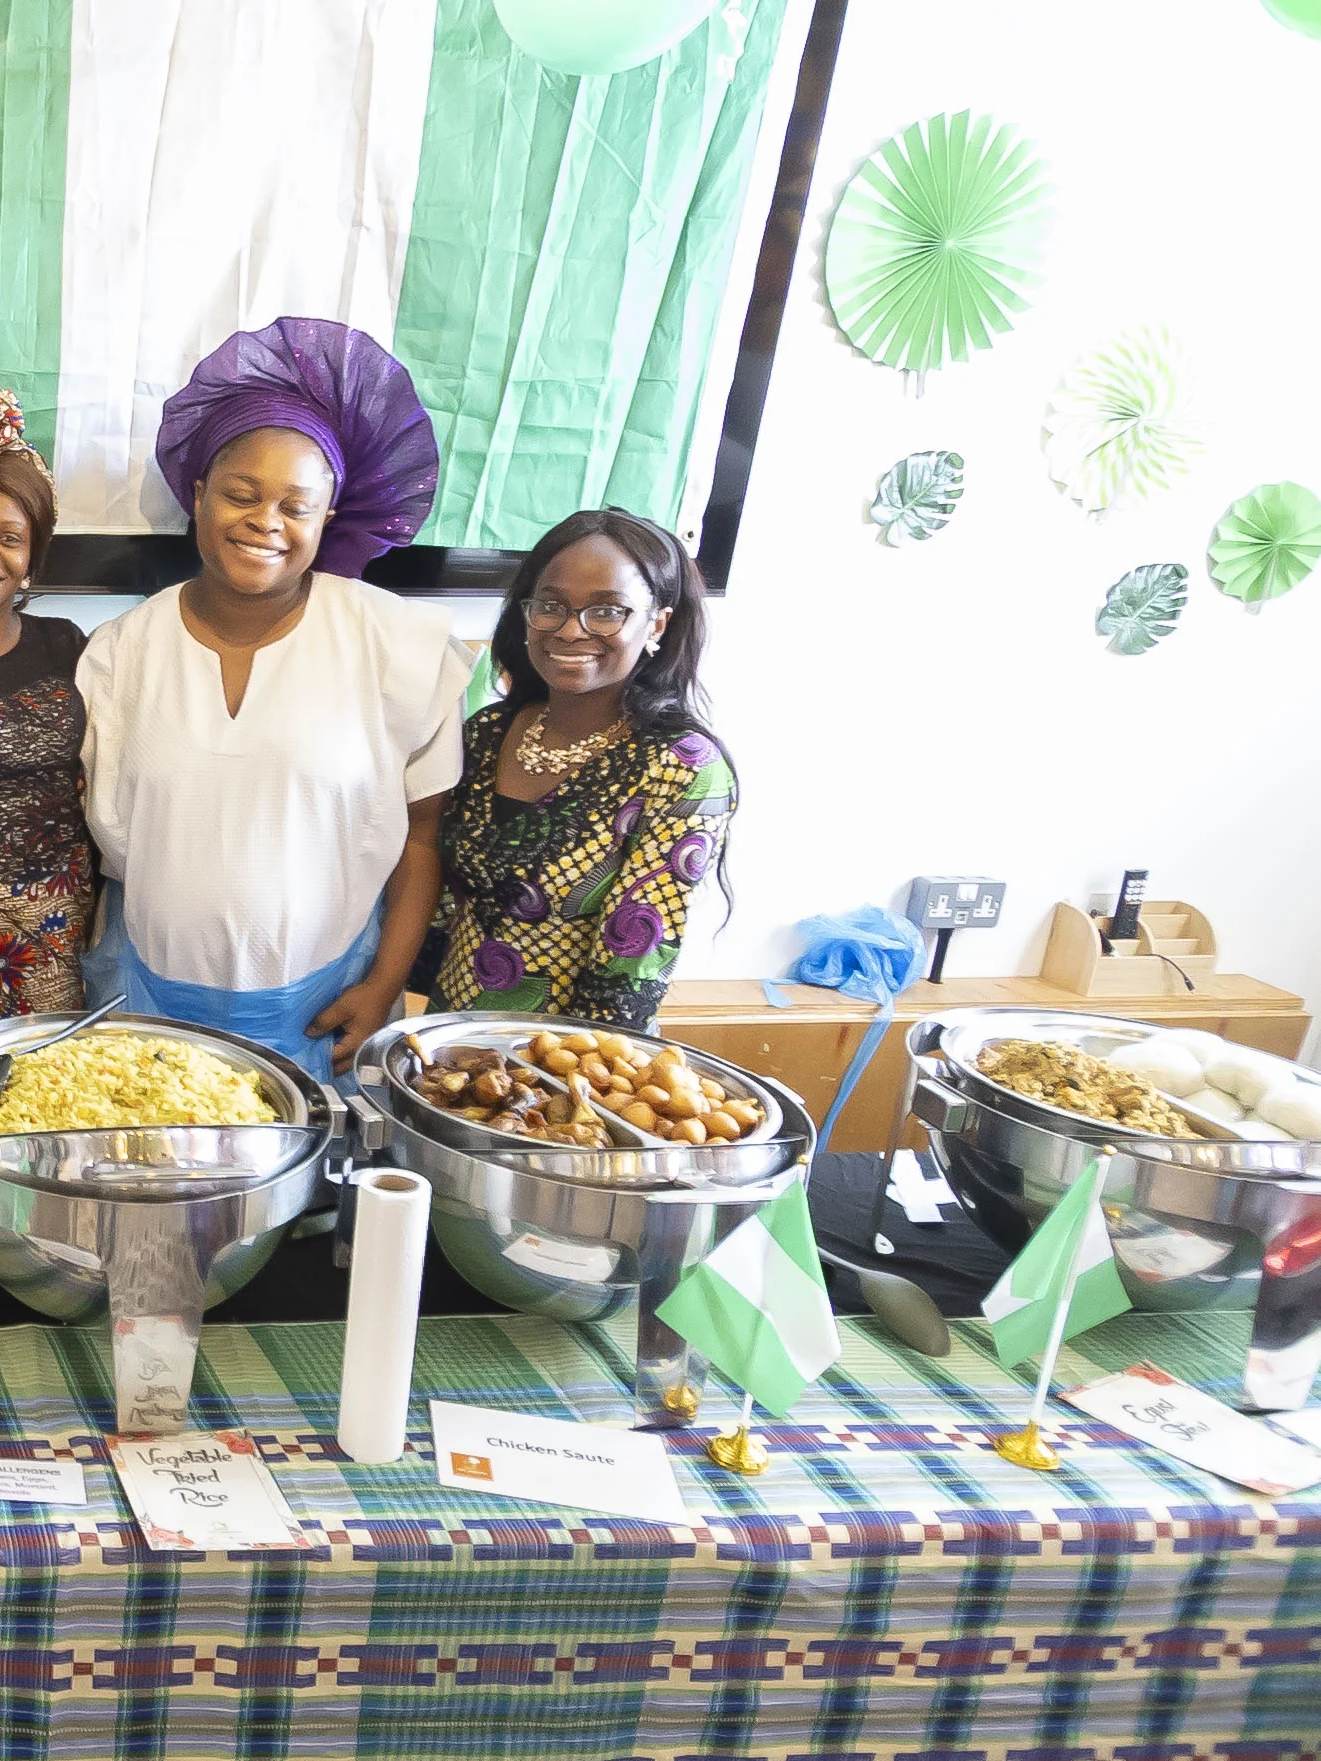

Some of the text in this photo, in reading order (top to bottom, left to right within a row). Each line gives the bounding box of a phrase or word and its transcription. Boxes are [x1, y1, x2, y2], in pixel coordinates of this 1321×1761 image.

[1121, 1397, 1176, 1424] Egusi
[136, 1447, 233, 1469] Vegetable
[486, 1437, 616, 1466] Chicken Saute
[152, 1468, 222, 1485] Fried
[169, 1487, 229, 1507] Rice
